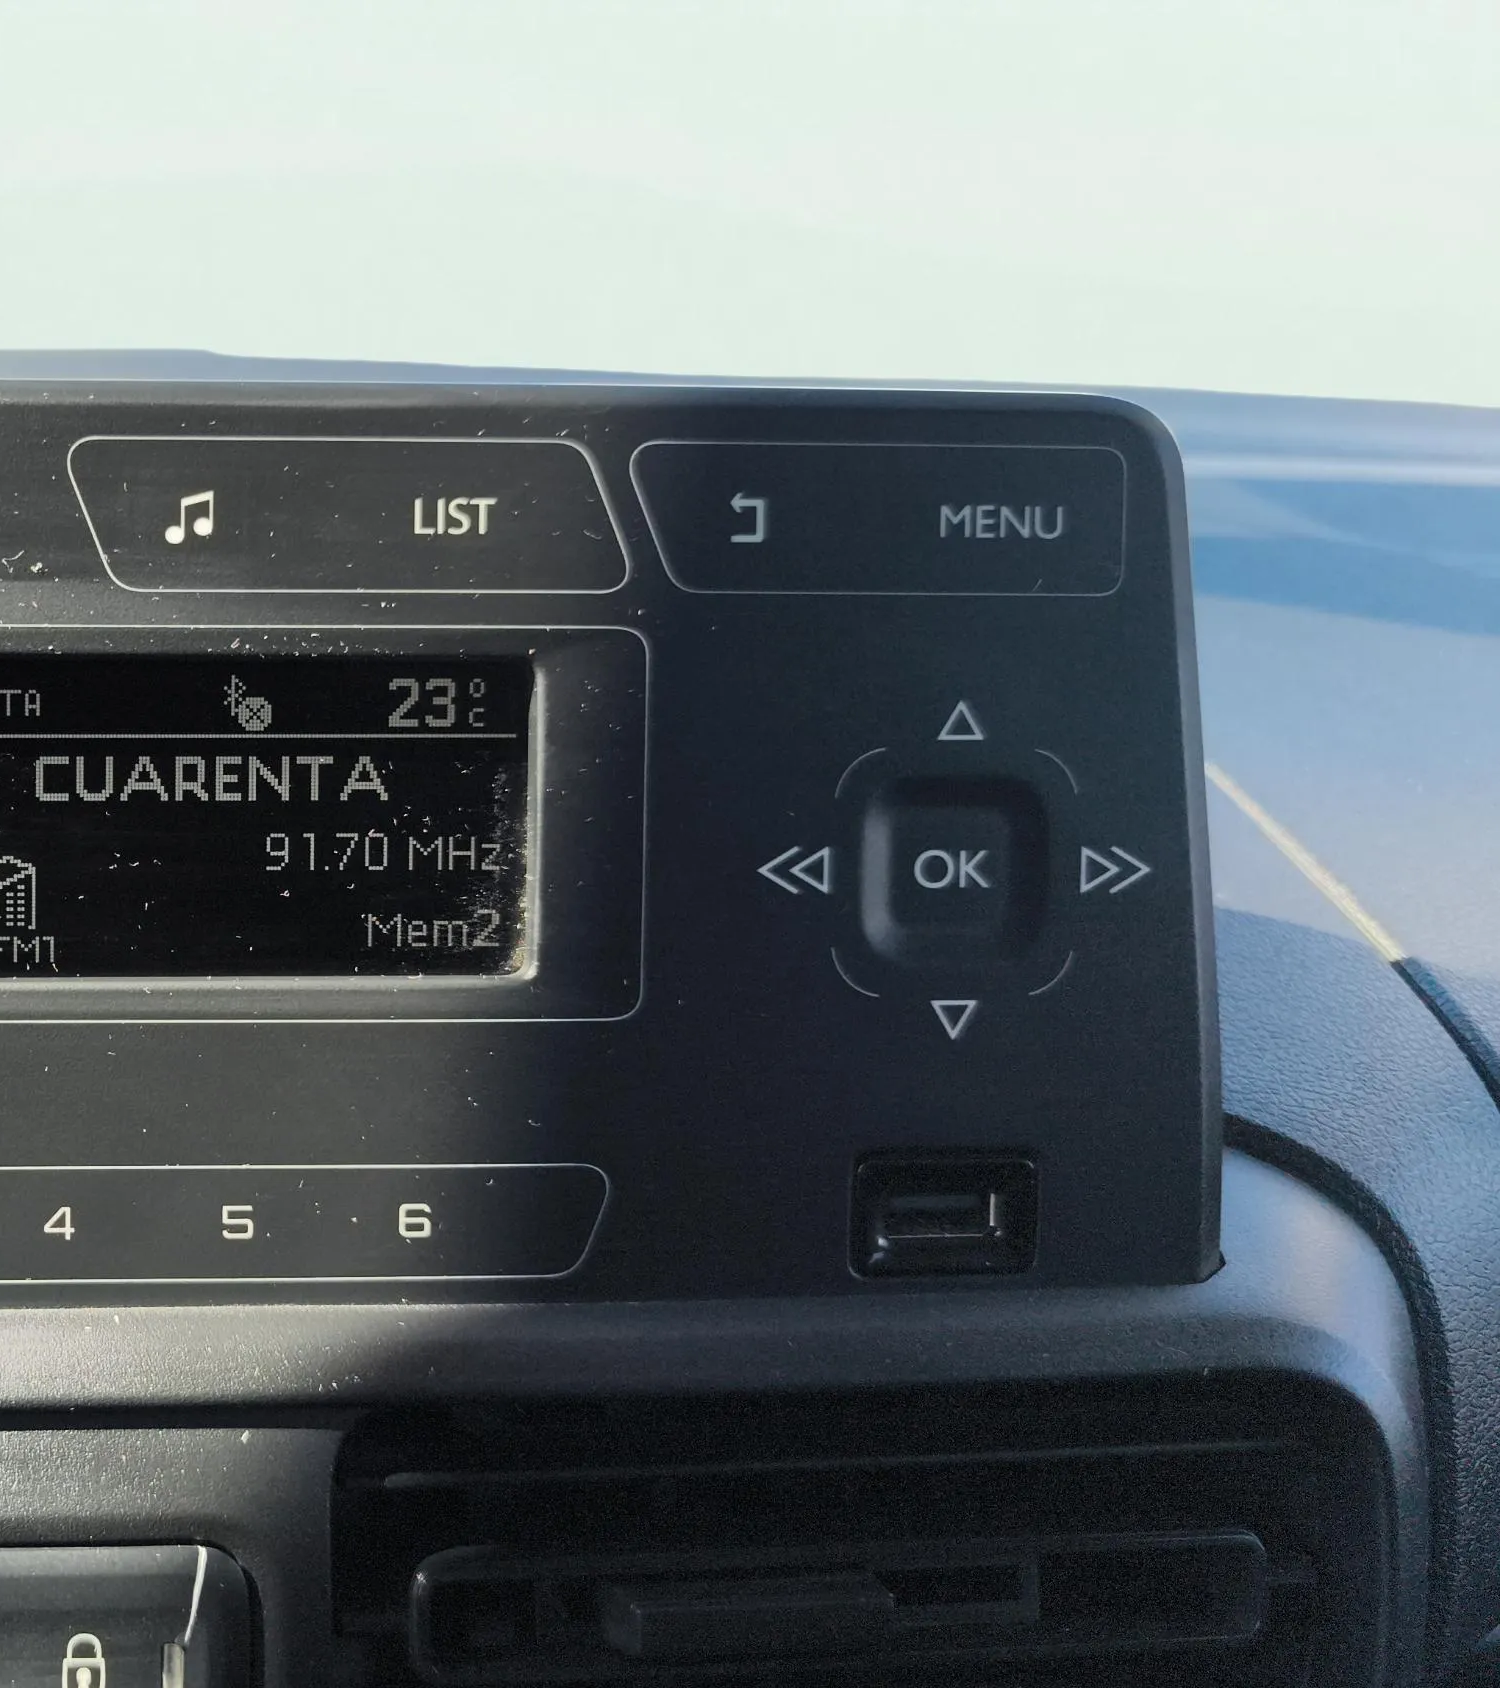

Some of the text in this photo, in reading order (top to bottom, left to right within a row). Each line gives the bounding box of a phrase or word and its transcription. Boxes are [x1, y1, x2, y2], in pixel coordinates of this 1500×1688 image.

[414, 497, 497, 535] LIST
[938, 505, 1065, 540] MENU
[35, 756, 389, 801] CUARENTA
[265, 833, 502, 872] 91.70 MHz
[913, 850, 989, 890] OK
[367, 909, 501, 948] Mem2
[43, 1206, 76, 1240] 4
[222, 1205, 254, 1239] 5
[397, 1203, 432, 1239] 6
